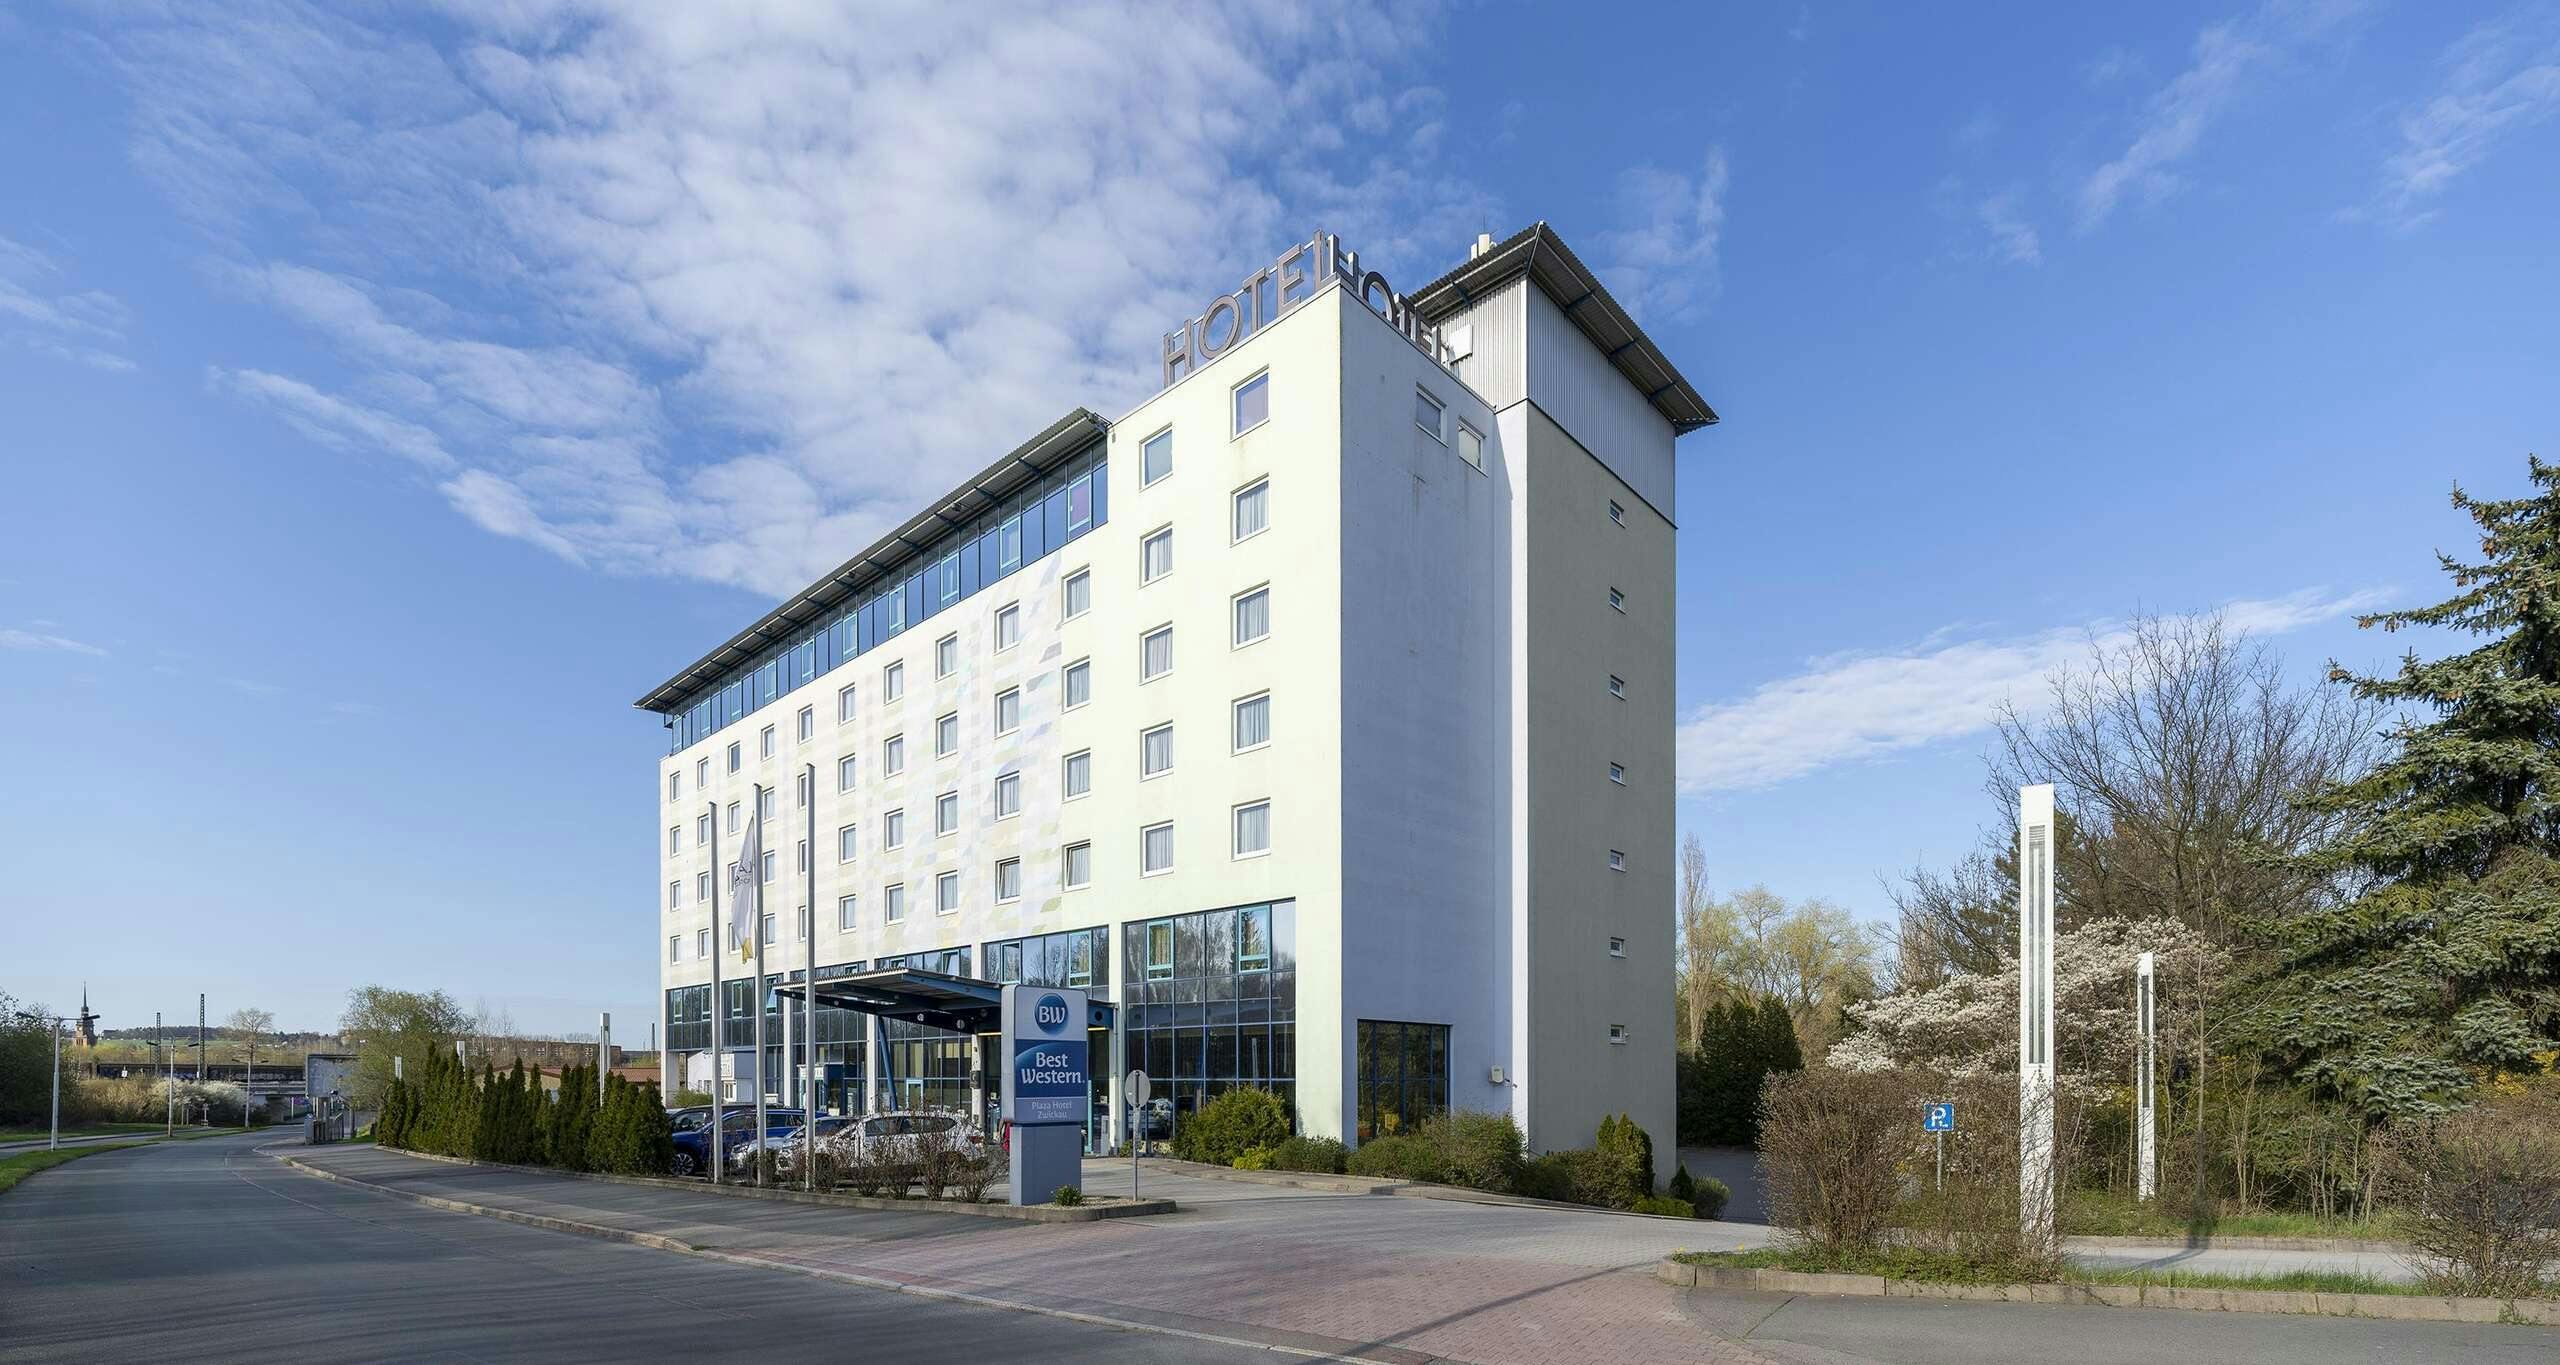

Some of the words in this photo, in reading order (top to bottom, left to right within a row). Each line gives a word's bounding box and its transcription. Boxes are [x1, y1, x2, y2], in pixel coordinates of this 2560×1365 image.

[1163, 228, 1337, 388] HOTEL
[1038, 1006, 1065, 1024] BW
[1036, 1051, 1068, 1068] Best
[1031, 1102, 1051, 1110] Plaza
[1053, 1101, 1072, 1109] Hotel
[1037, 1110, 1067, 1119] Zwickau
